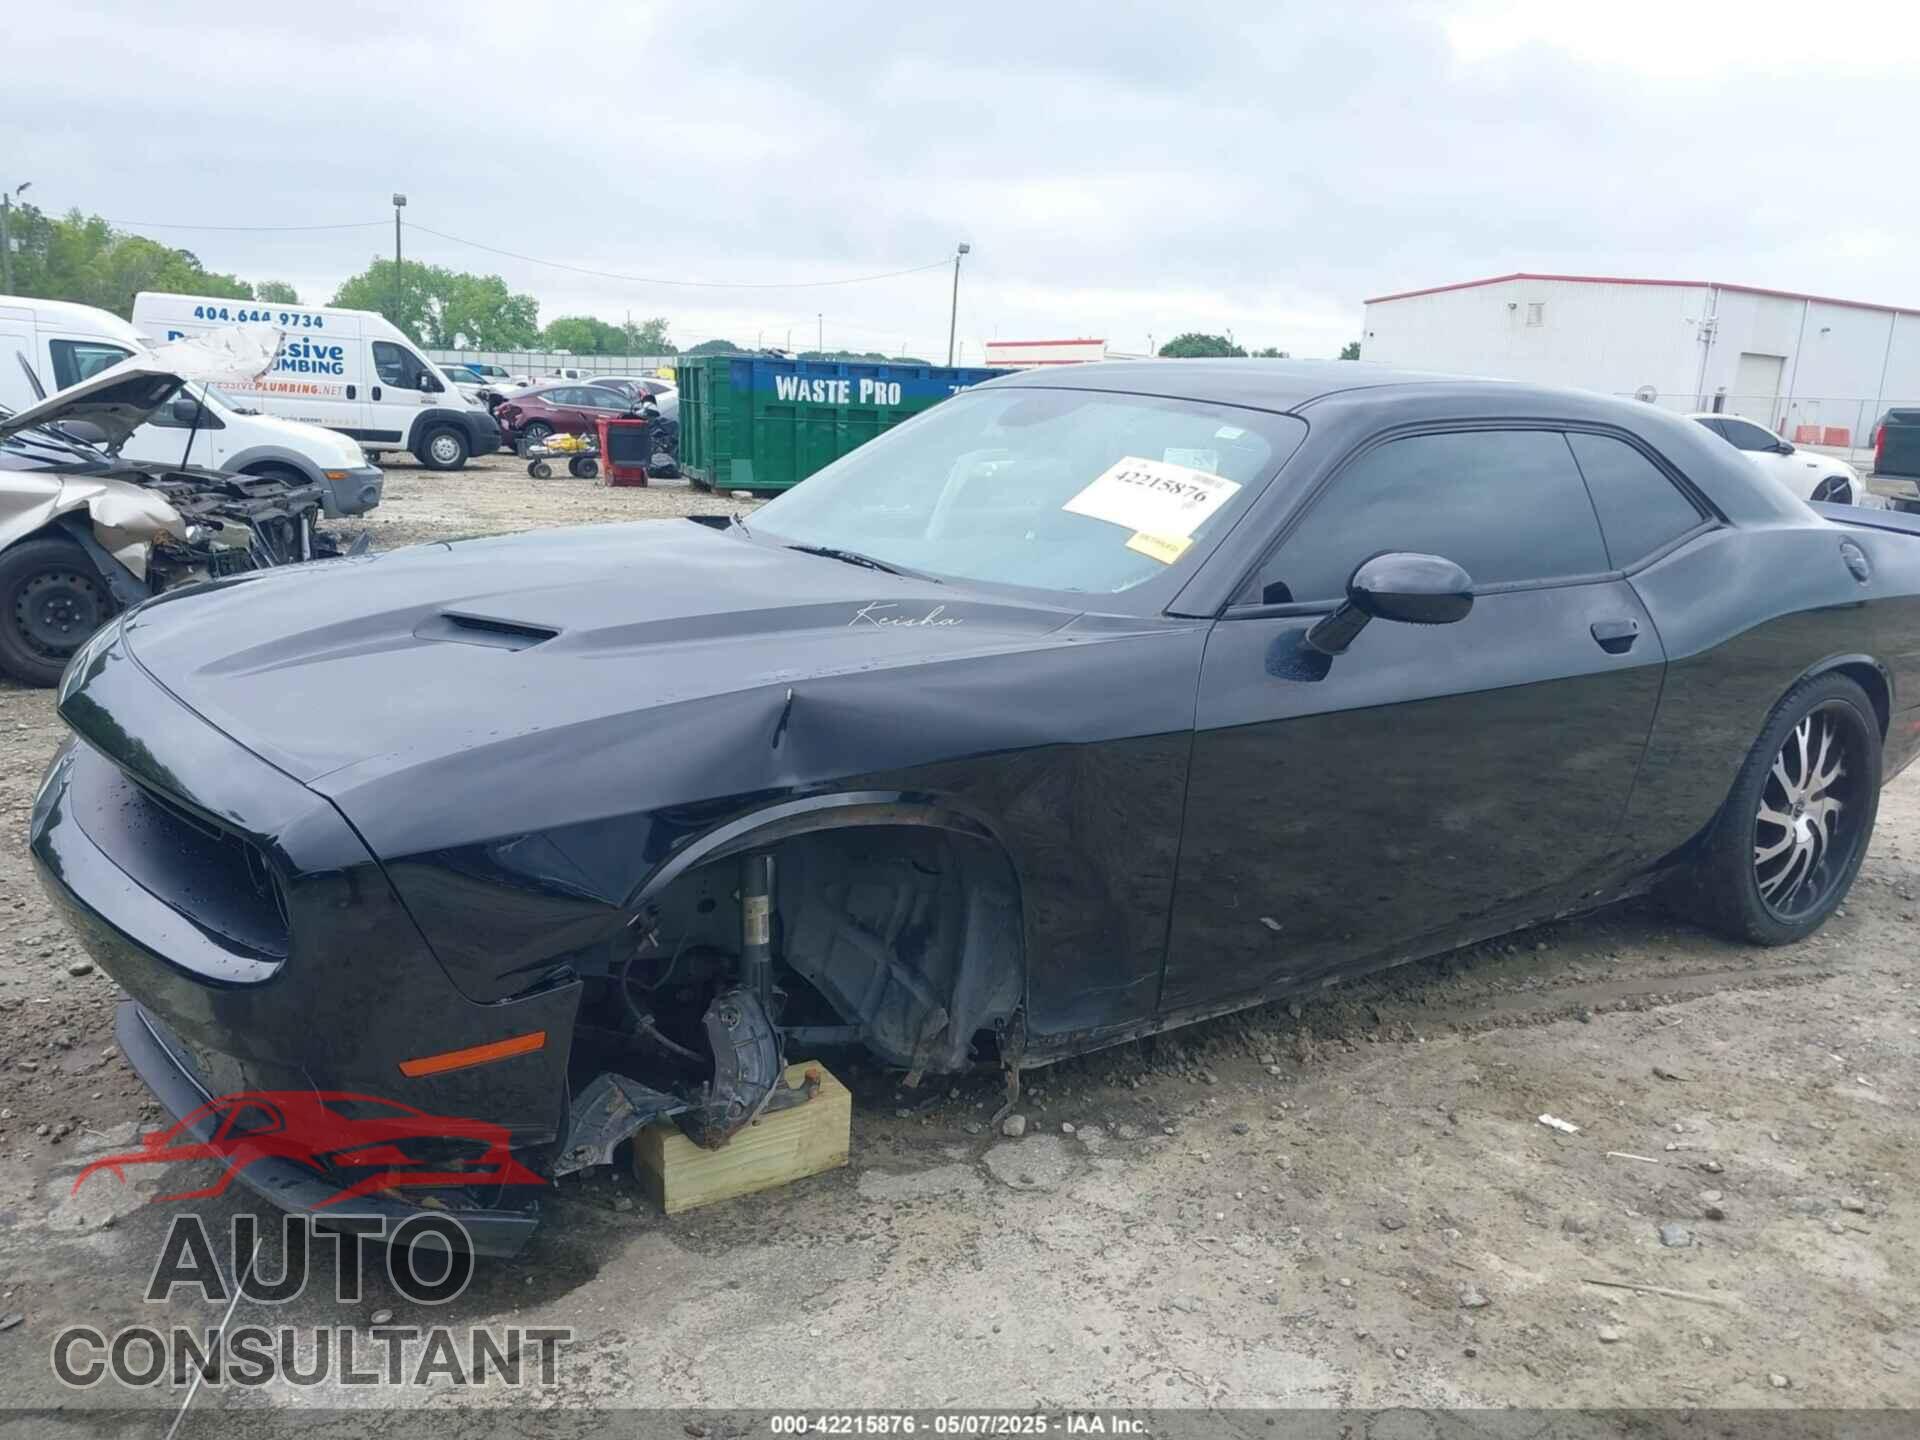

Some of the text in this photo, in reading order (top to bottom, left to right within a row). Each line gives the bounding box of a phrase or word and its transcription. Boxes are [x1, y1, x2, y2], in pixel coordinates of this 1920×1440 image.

[194, 306, 323, 328] 404.6449734
[775, 375, 901, 406] WASTE PRO
[1115, 470, 1207, 503] 42215876
[848, 601, 964, 628] Keisha
